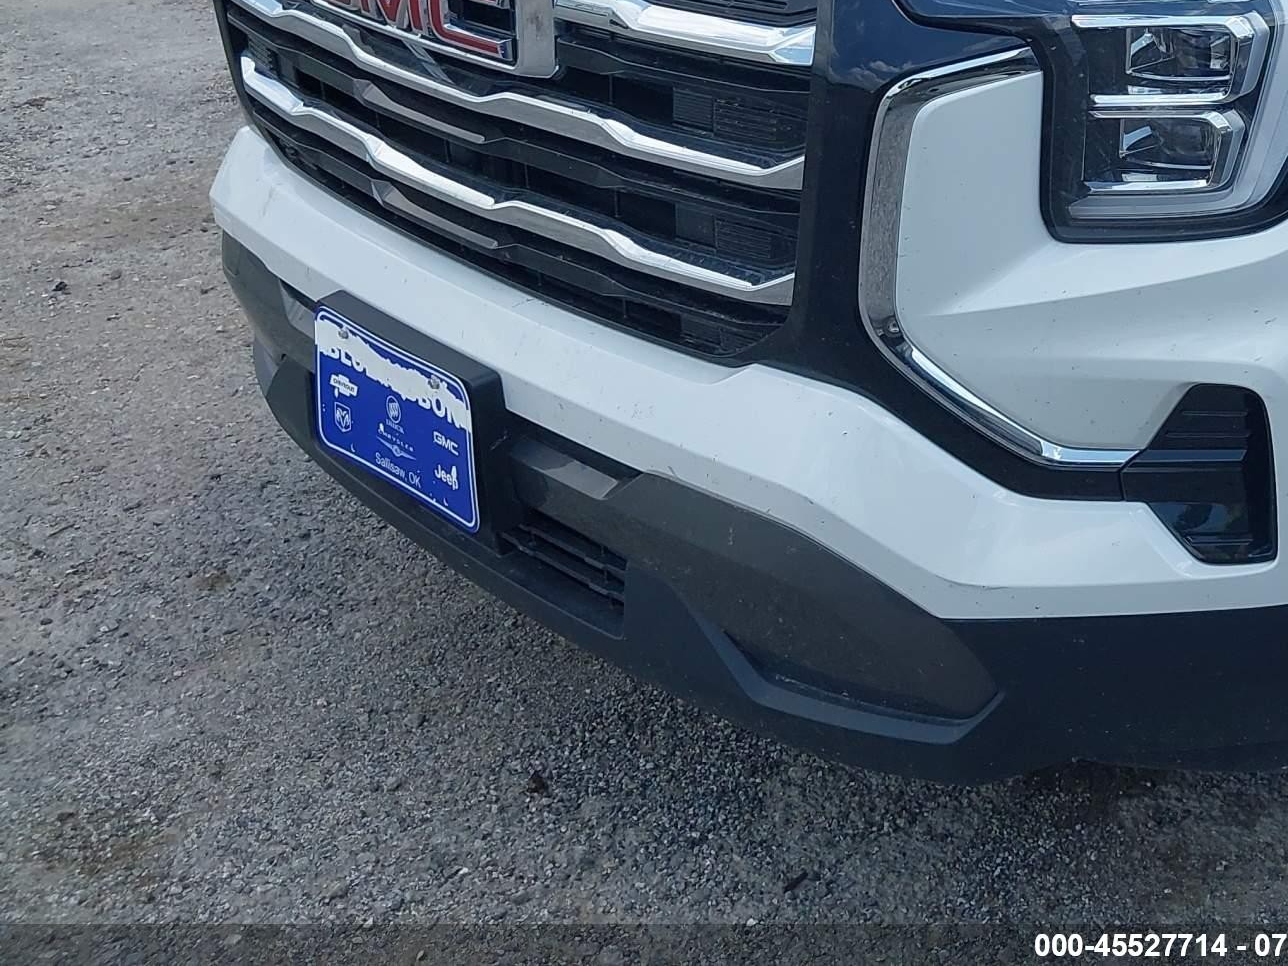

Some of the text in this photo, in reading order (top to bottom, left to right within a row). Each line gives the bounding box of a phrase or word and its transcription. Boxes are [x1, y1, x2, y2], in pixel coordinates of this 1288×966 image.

[433, 430, 459, 456] GMC
[375, 451, 421, 489] Sallisaw, OK
[434, 464, 459, 491] Jeep
